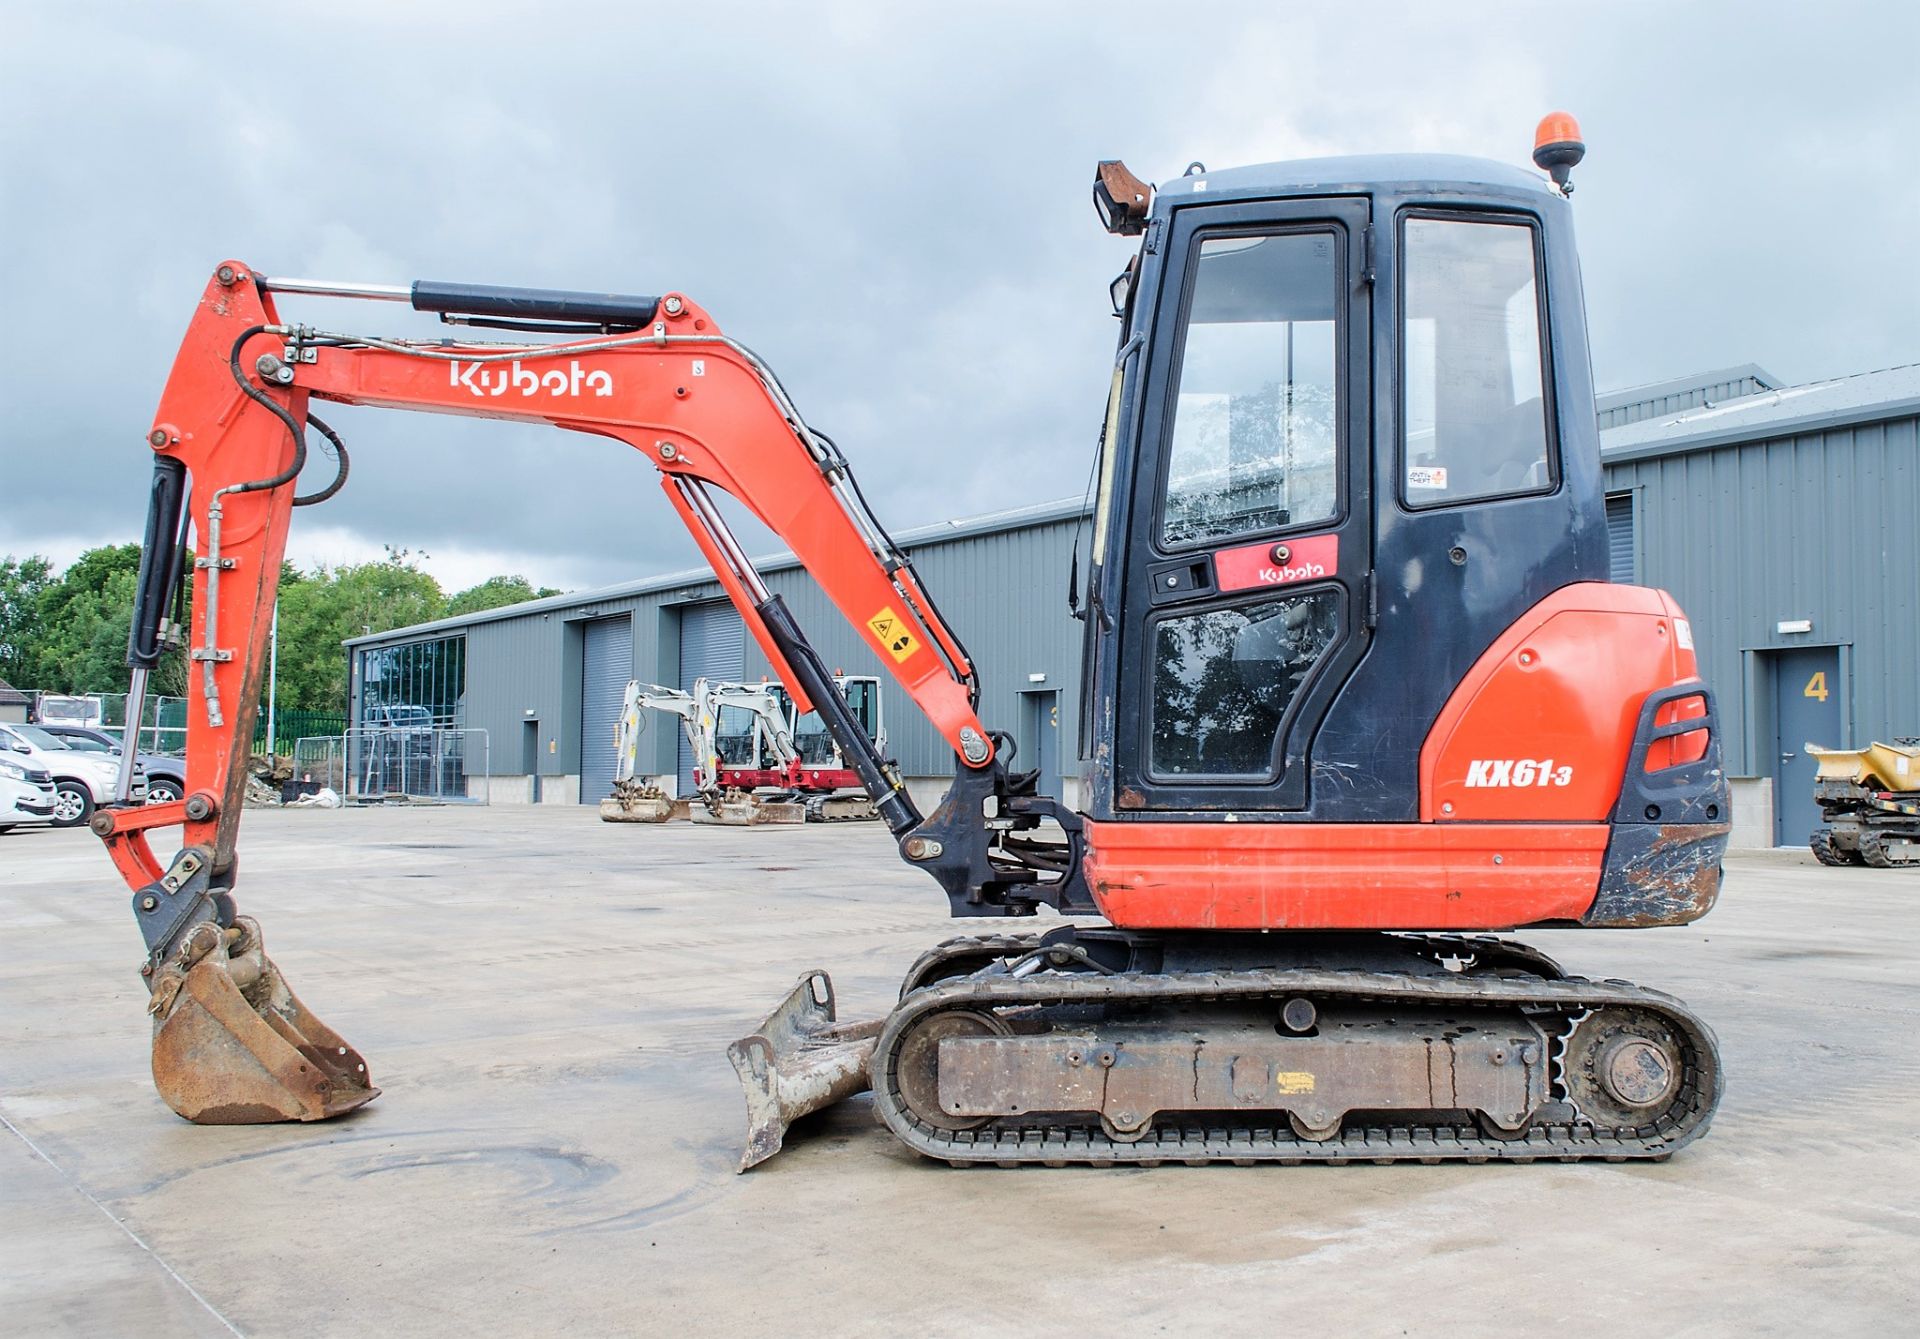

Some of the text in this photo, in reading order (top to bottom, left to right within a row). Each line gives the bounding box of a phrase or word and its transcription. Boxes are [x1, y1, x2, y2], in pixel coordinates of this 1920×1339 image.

[450, 360, 613, 397] Kubota
[1259, 562, 1325, 583] Kubota
[1804, 671, 1829, 702] 4
[1464, 759, 1573, 788] KX61-3
